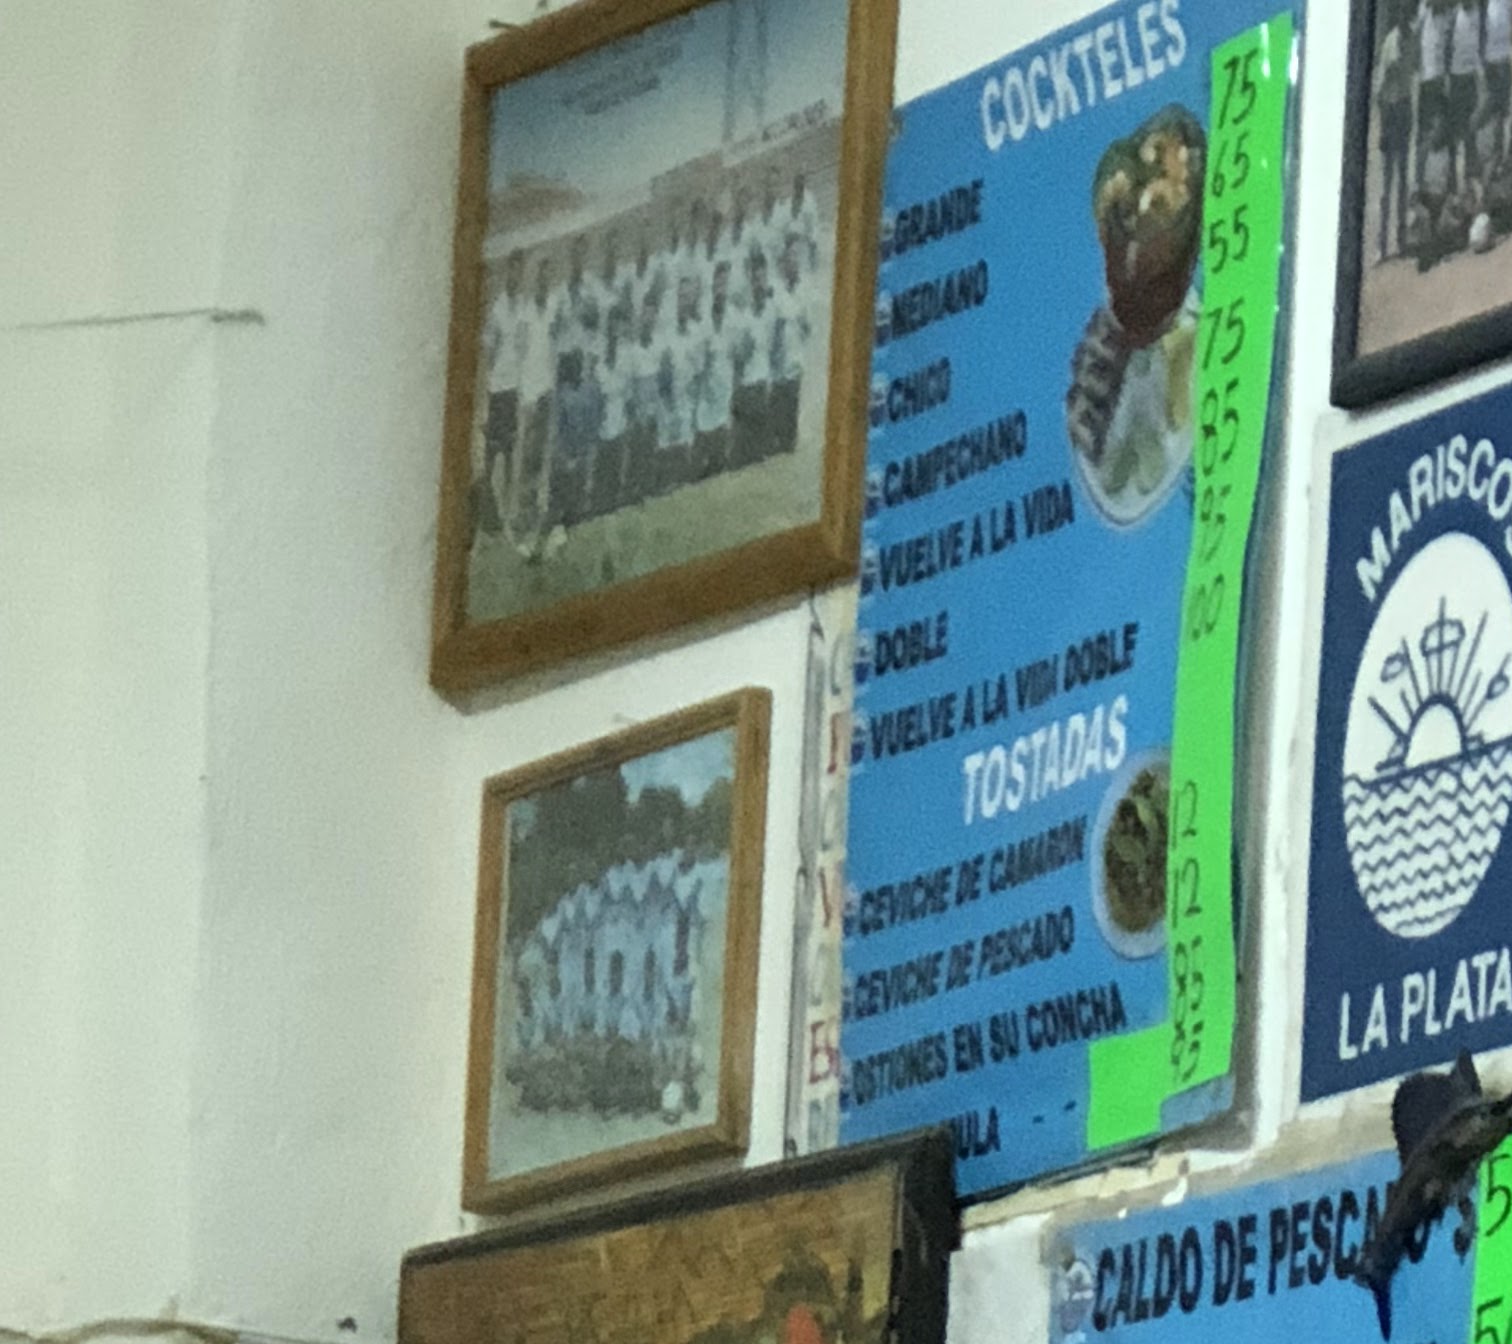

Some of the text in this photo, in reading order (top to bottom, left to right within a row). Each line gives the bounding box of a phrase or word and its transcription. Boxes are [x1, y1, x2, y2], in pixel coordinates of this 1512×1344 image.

[980, 0, 1187, 150] COCKTELES
[1221, 49, 1258, 129] 75
[1211, 132, 1250, 197] 65
[895, 178, 983, 256] GRANDE
[1209, 206, 1249, 273] 55
[891, 259, 988, 339] MEDIANO
[1204, 299, 1245, 371] 75
[887, 357, 950, 422] CHICO
[1202, 378, 1239, 477] 85
[883, 409, 1026, 509] CAMPECHANO
[879, 480, 1075, 592] VUELVE A LA VIDA
[869, 693, 956, 760] VUELVE
[961, 686, 977, 729] A
[982, 673, 1008, 725] LA
[1063, 621, 1140, 693] DOBLE
[875, 611, 948, 676] DOBLE
[963, 695, 1129, 825] TOSTADAS
[858, 815, 1086, 936] CEVICHE DE CAMARON
[854, 905, 1075, 1019] CEVICHE DE PESCADO
[852, 980, 1127, 1105] OSTIONES EN SU CONCHA
[1339, 983, 1388, 1060] LA
[1092, 1225, 1201, 1332] CALDO
[1211, 1212, 1257, 1307] DE
